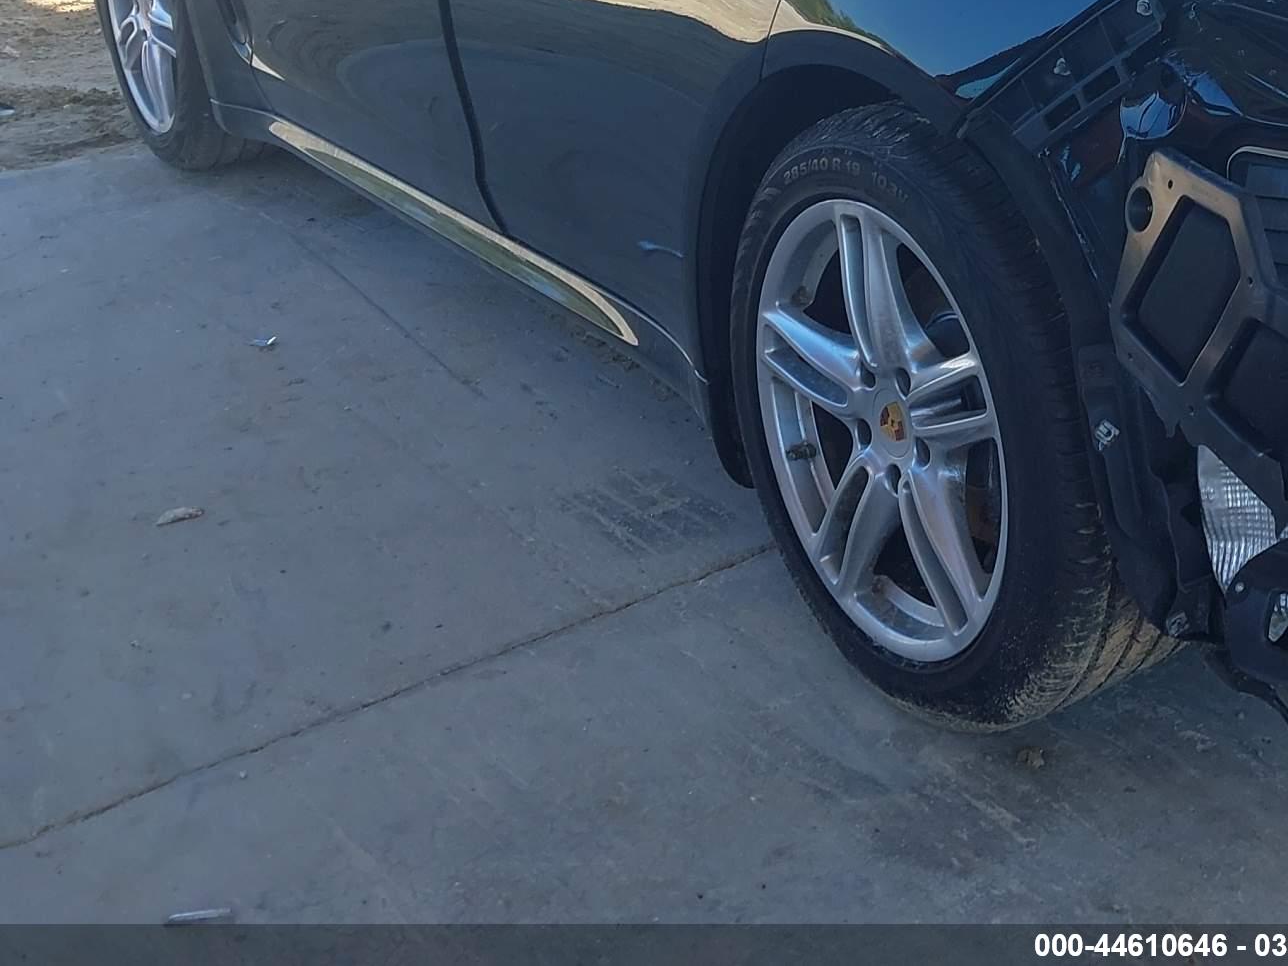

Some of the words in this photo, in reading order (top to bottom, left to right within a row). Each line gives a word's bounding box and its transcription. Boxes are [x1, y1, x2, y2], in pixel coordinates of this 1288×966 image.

[783, 157, 829, 185] 285/40
[832, 157, 842, 171] R
[845, 159, 861, 177] 19
